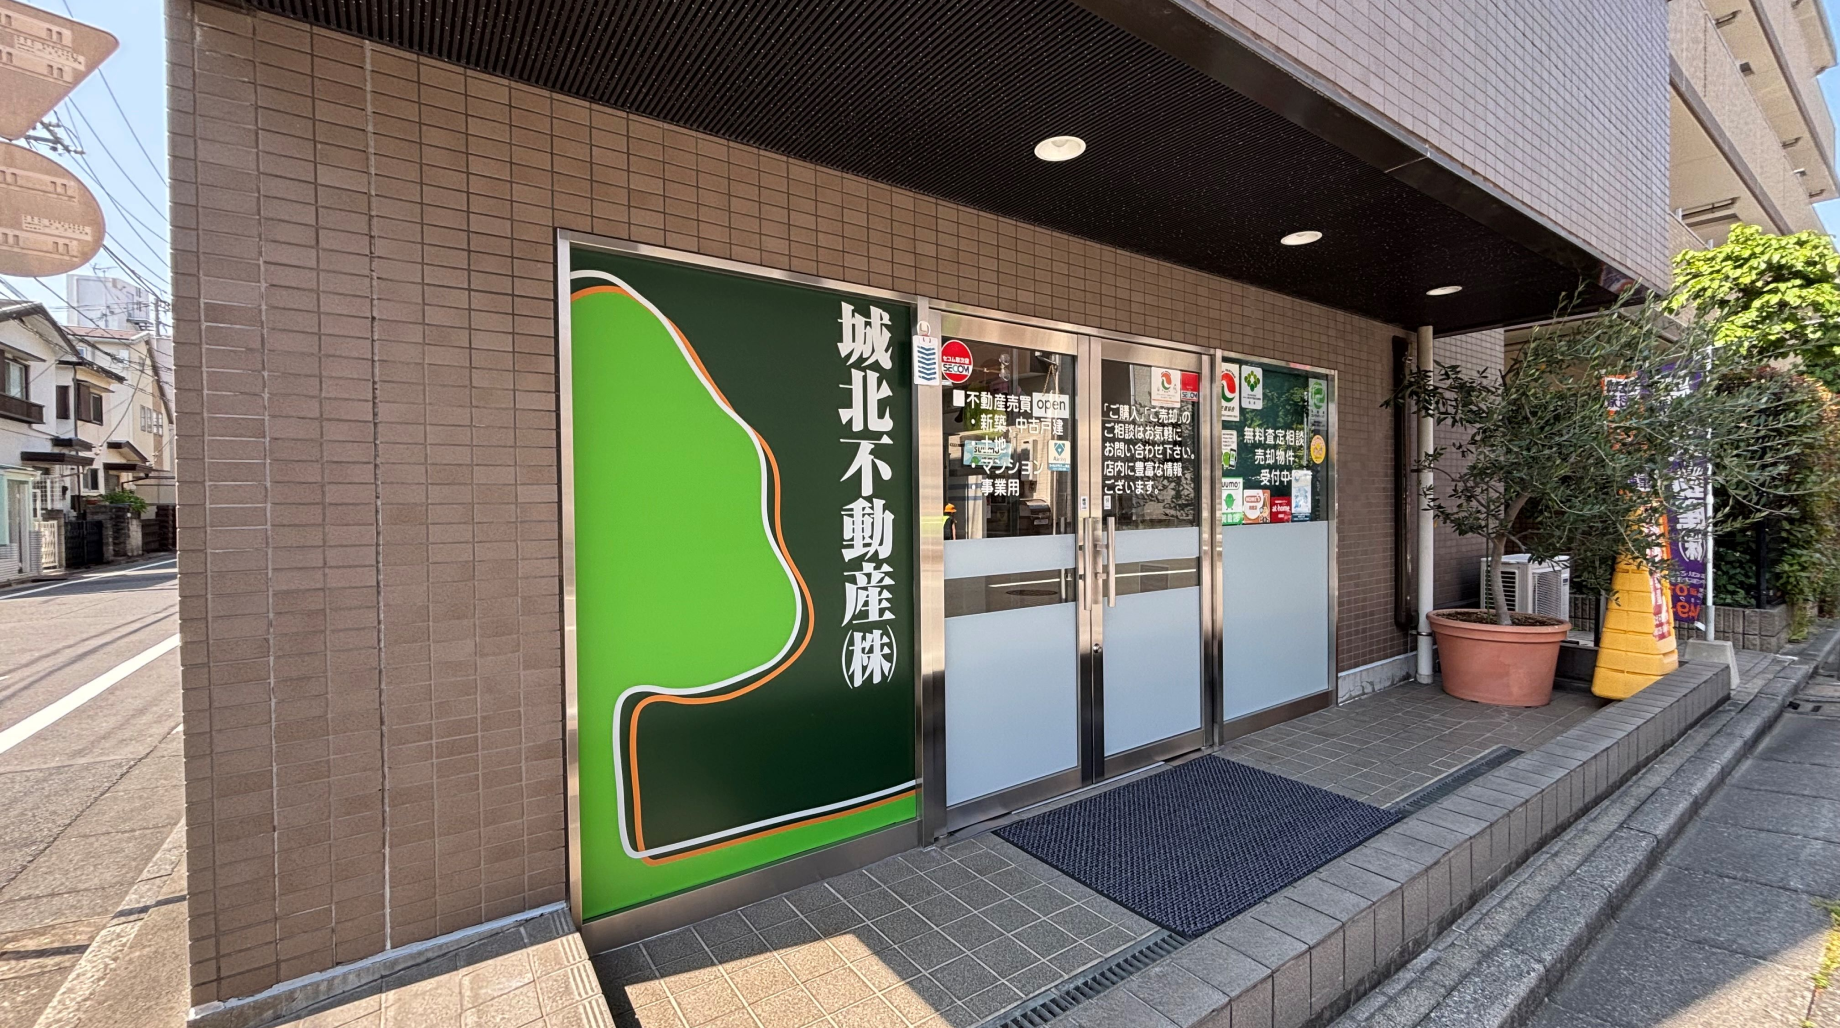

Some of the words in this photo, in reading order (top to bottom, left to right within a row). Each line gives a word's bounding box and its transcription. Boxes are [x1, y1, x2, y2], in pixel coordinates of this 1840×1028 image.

[943, 363, 970, 375] SECOM
[1036, 398, 1066, 413] open
[1103, 403, 1191, 424] 「ご購入」「ご売却」の
[1104, 423, 1182, 441] ご相談はお気軽に
[1243, 426, 1304, 446] 無料査定相談
[1104, 441, 1195, 460] お問い合わせ下さい。
[1254, 448, 1295, 465] 売却物件
[1103, 461, 1183, 477] 店内に豊富な情報
[1260, 468, 1291, 487] 受付中
[837, 302, 897, 689] 城北不動産(株)
[1104, 479, 1159, 495] ございます。
